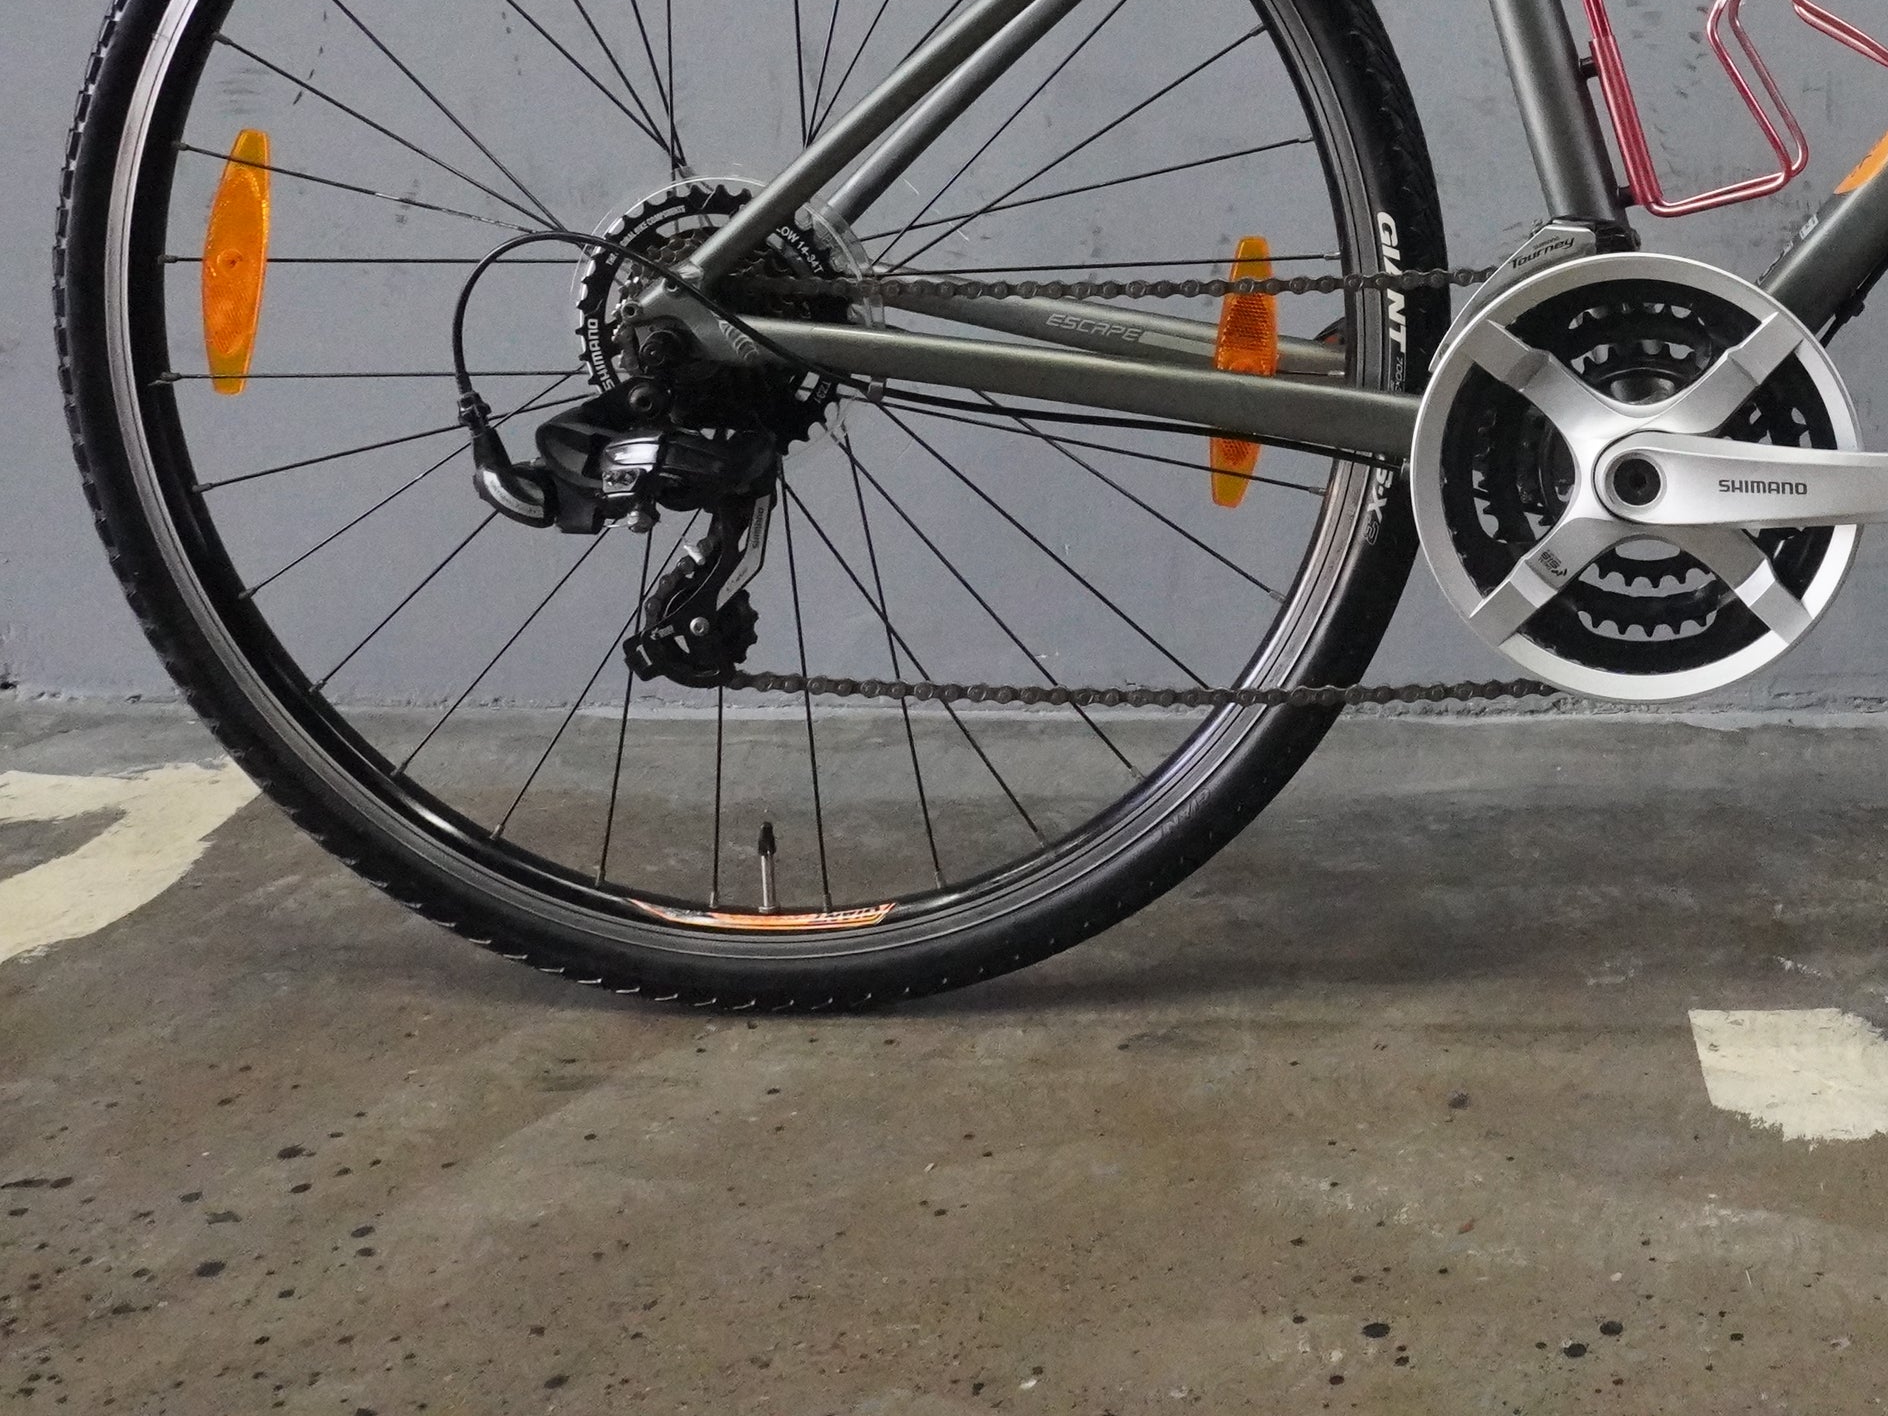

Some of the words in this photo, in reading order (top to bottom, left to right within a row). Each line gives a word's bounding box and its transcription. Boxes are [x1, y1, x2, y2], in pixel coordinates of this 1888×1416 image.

[798, 238, 824, 273] 14-34T
[1508, 237, 1576, 270] Tourney
[1046, 313, 1142, 342] ESCAPE
[587, 317, 616, 393] SHIMANO
[1394, 356, 1404, 392] 700x3
[1718, 479, 1808, 495] SHIMANO
